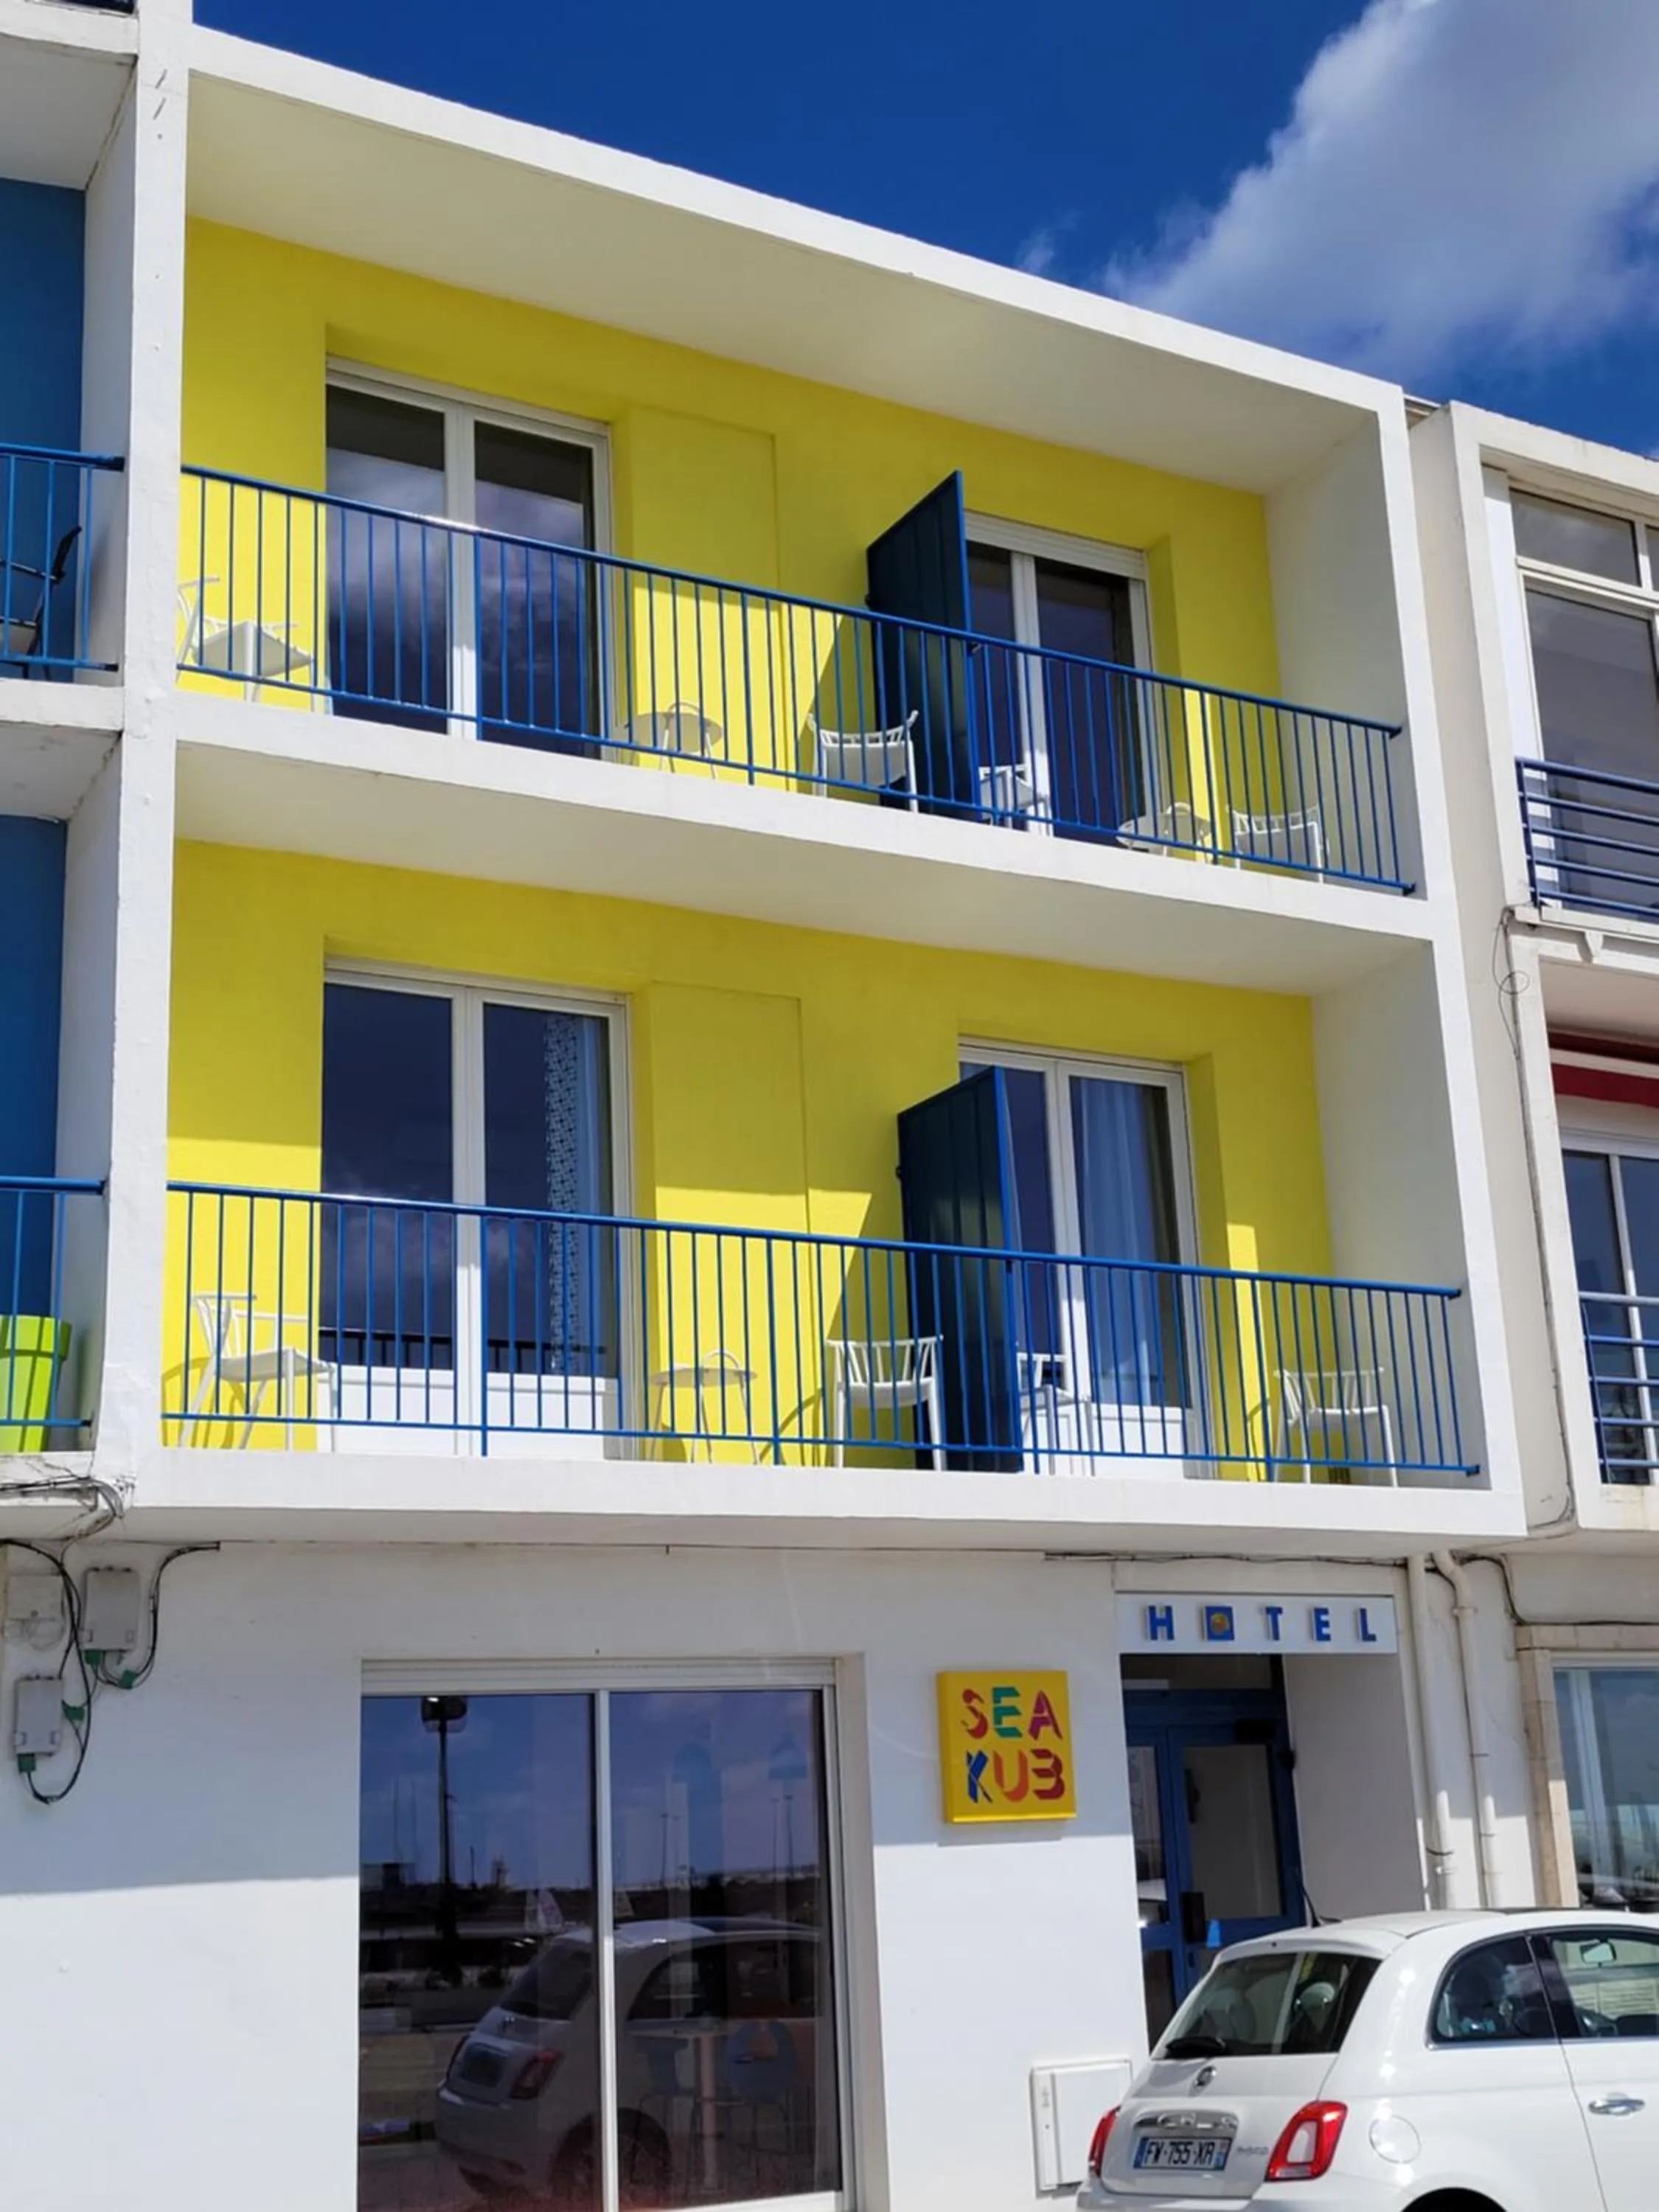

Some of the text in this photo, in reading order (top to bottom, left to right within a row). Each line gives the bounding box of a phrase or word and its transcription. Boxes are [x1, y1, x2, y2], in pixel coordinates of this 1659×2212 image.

[1147, 1605, 1377, 1642] HOTEL
[961, 1686, 1063, 1740] SEA
[966, 1748, 1065, 1804] KUB
